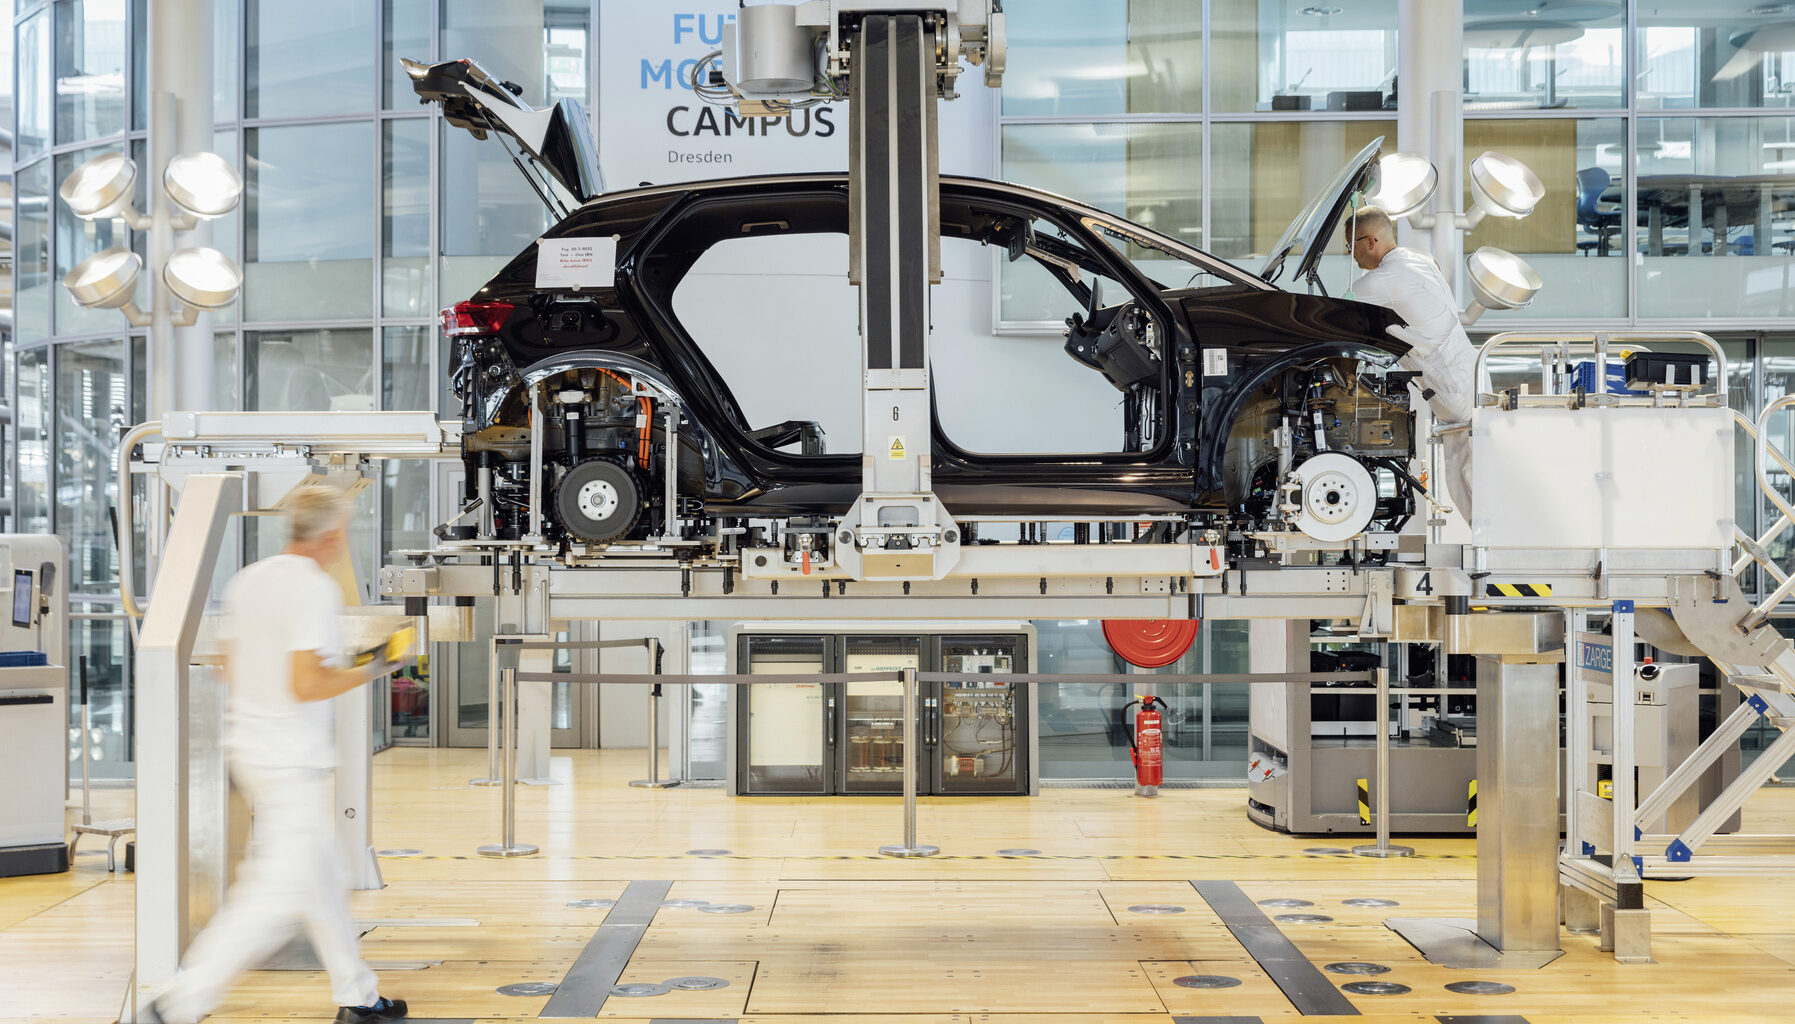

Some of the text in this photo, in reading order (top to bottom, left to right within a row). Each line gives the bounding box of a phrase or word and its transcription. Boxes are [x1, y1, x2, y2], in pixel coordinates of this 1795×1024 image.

[667, 106, 835, 137] CAMPUS
[668, 150, 732, 164] Dresden
[893, 406, 899, 421] 6
[1416, 572, 1433, 596] 4
